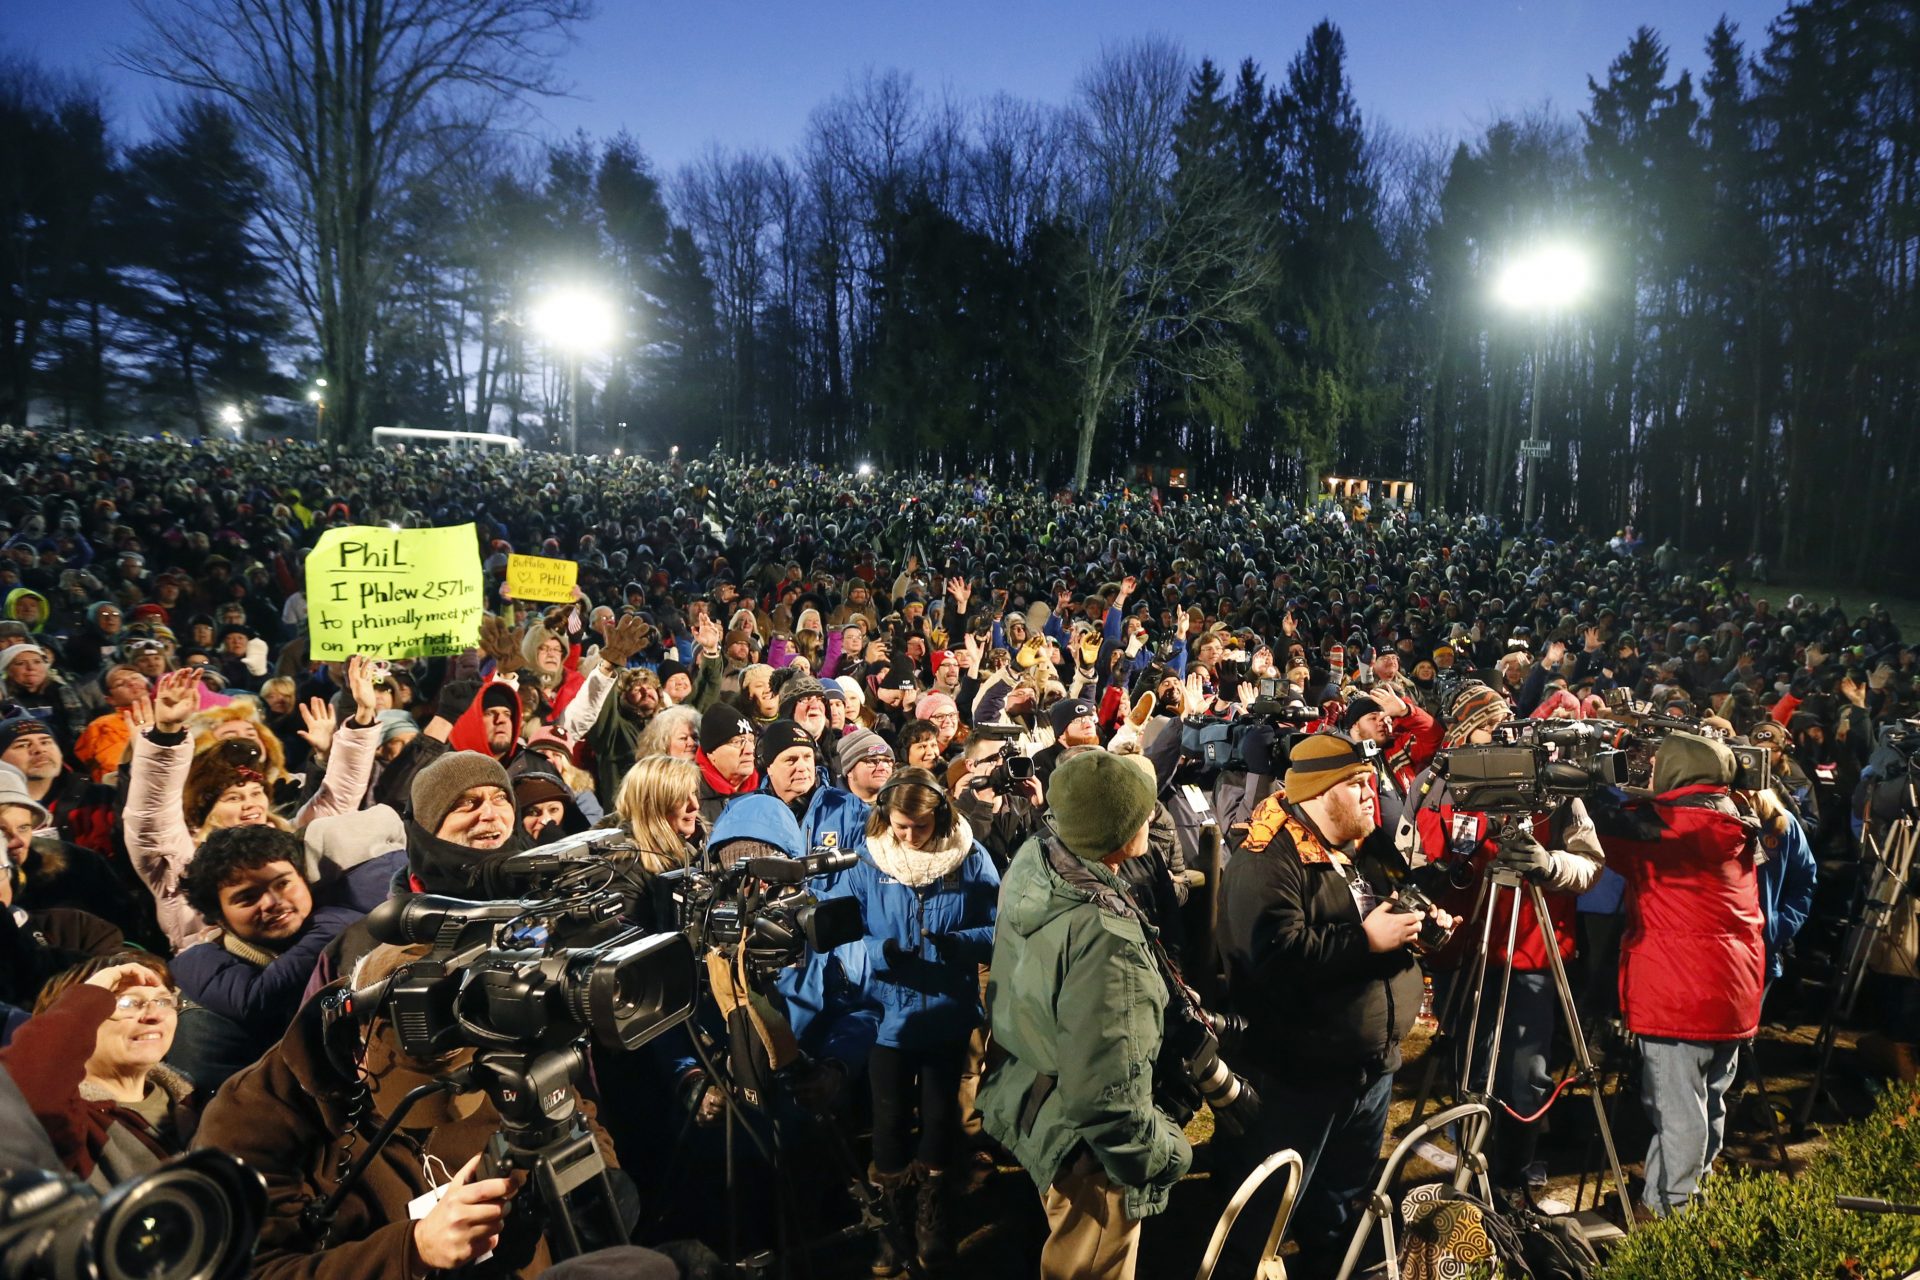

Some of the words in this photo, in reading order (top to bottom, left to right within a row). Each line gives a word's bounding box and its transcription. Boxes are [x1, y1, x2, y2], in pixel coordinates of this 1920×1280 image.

[539, 572, 569, 586] PHIL
[330, 581, 348, 601] I
[319, 610, 343, 630] to
[352, 608, 423, 639] phinally
[425, 607, 458, 621] meet
[321, 642, 343, 652] on
[356, 643, 384, 658] my
[823, 833, 836, 846] 6
